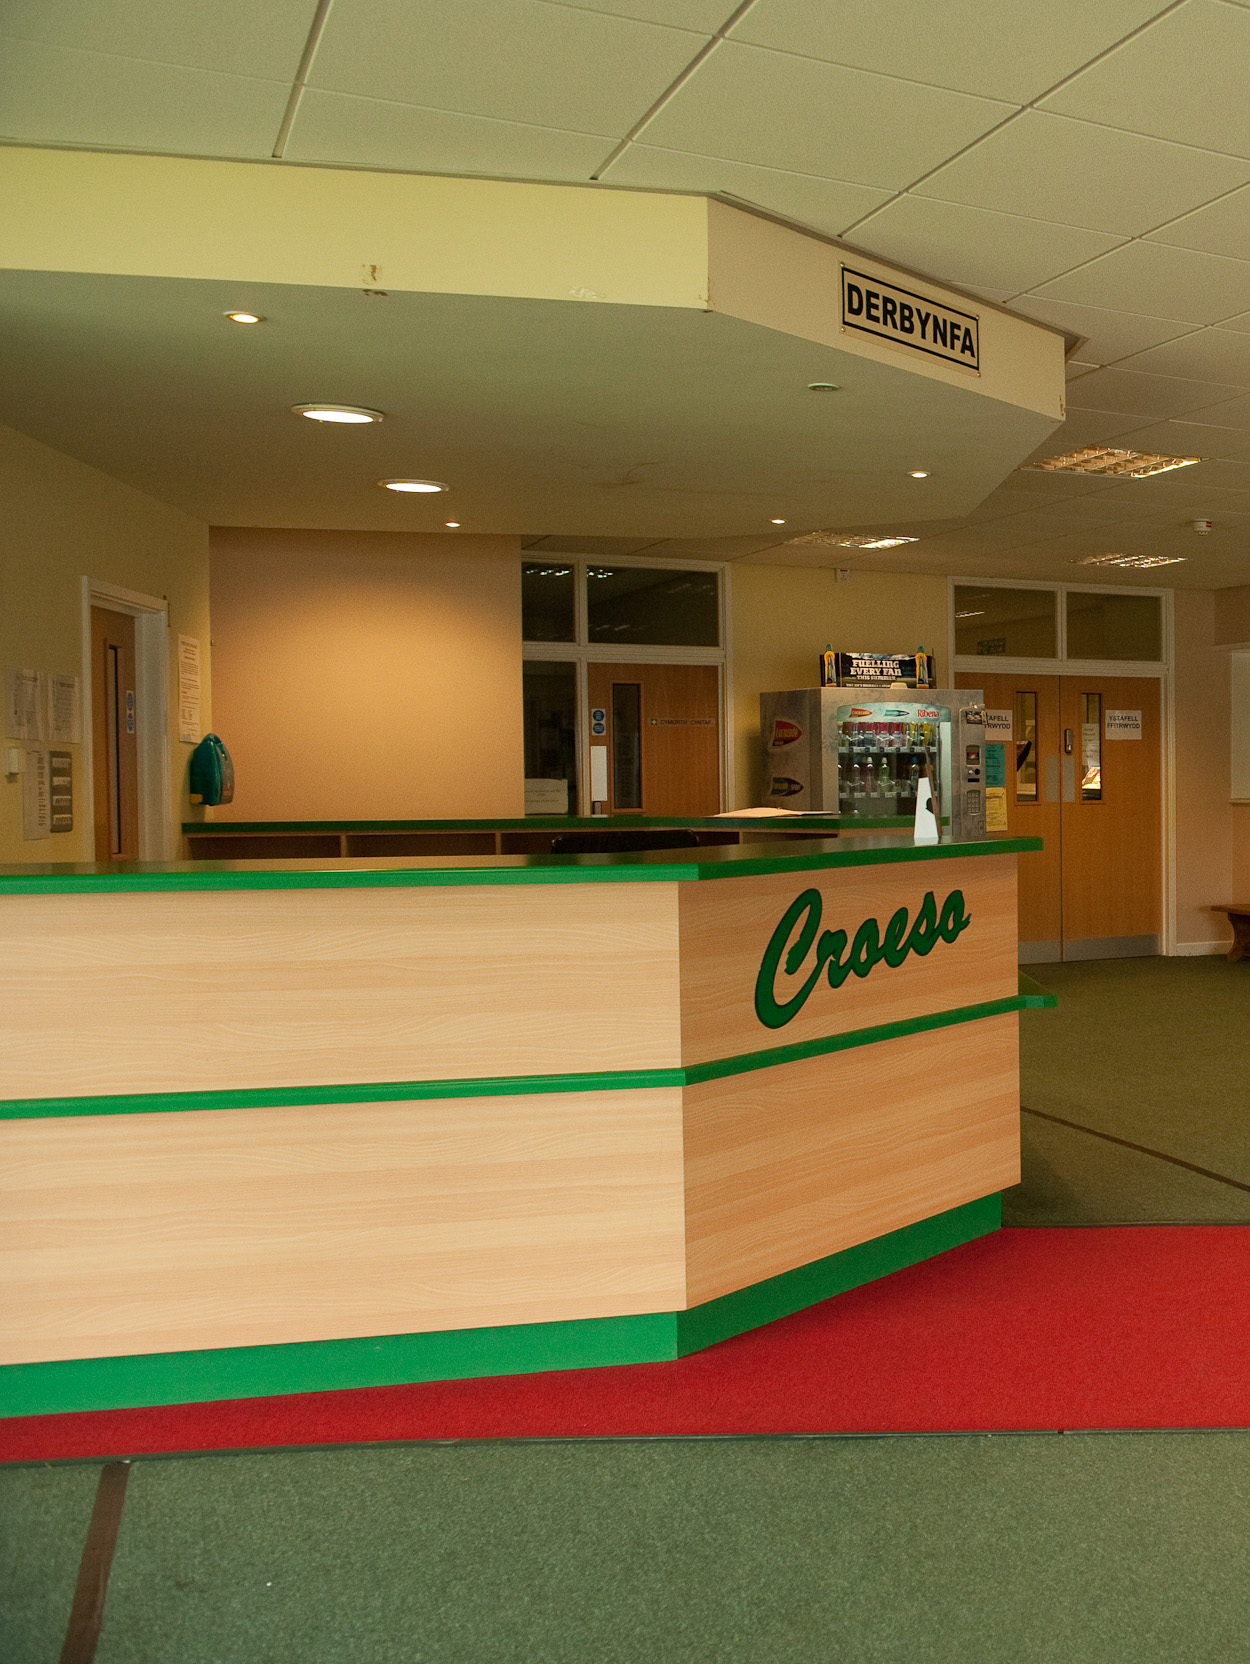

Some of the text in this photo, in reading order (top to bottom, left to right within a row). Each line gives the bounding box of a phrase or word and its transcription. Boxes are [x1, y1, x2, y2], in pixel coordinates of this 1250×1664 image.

[847, 282, 976, 358] DERBYNFA
[850, 667, 880, 675] EVERY
[917, 709, 939, 718] Ribena
[755, 888, 972, 1029] Croeso
